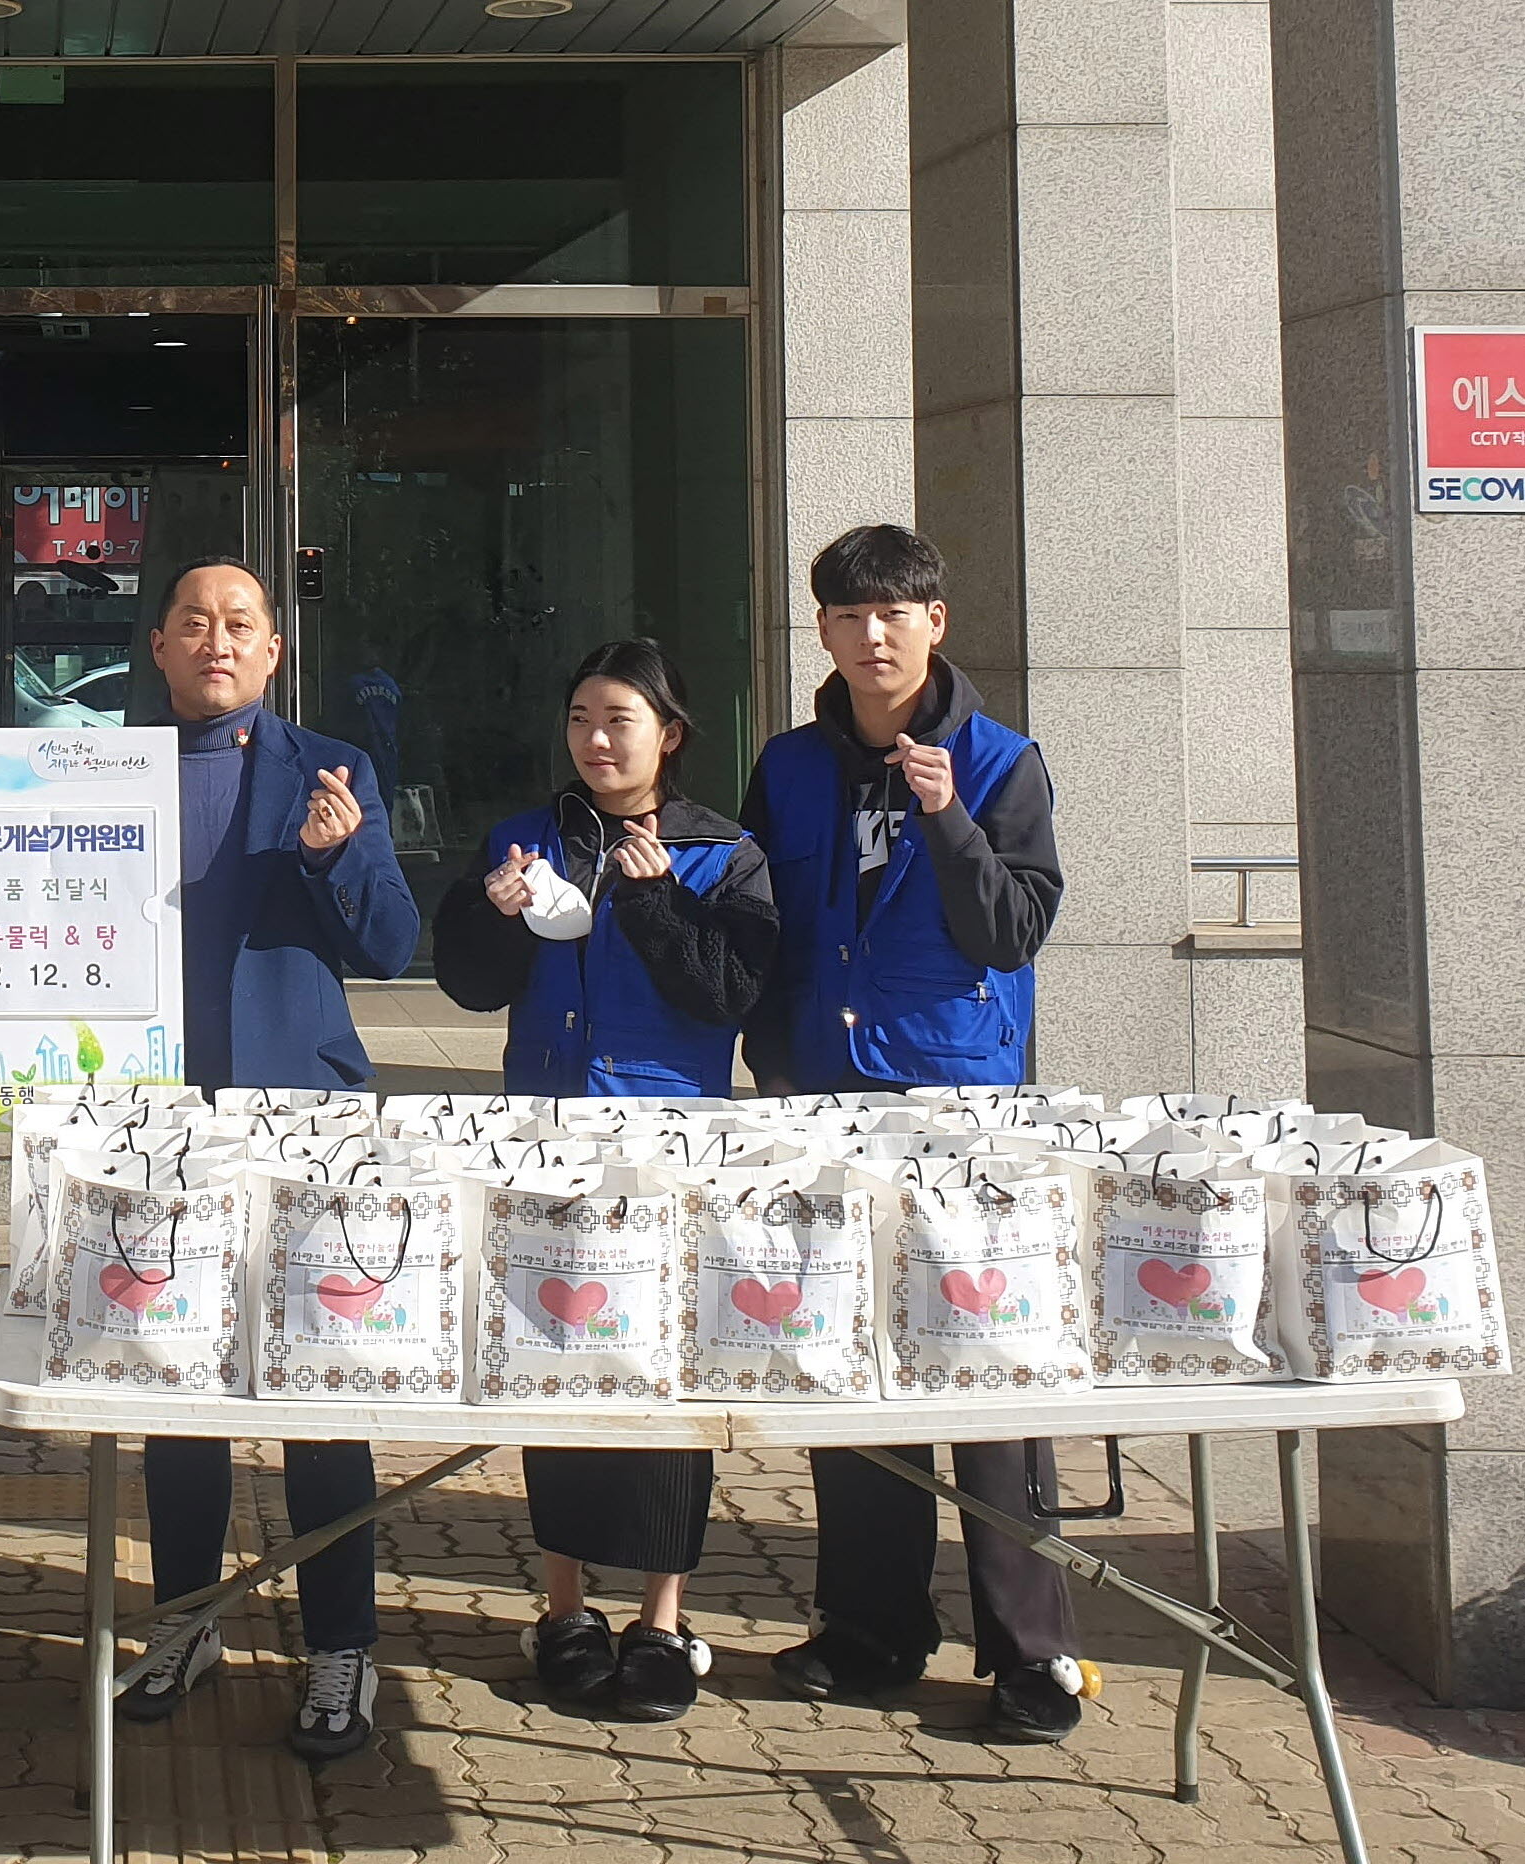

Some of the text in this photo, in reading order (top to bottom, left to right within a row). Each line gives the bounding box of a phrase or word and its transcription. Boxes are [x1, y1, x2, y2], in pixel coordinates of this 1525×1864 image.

[1471, 432, 1510, 446] CCTV
[1429, 477, 1524, 501] SECOM
[122, 756, 150, 769] 안산
[41, 877, 107, 901] 전달식
[65, 926, 80, 945] &
[97, 925, 117, 950] 탕
[29, 964, 67, 989] 12.
[86, 964, 111, 989] 8.
[81, 1236, 106, 1252] 사랑의
[1109, 1235, 1144, 1247] 사랑의
[291, 1252, 324, 1263] 사랑의
[512, 1254, 545, 1266] 사랑의
[910, 1249, 945, 1259] 사랑의
[1325, 1250, 1360, 1259] 사랑의
[704, 1256, 737, 1267] 사랑의
